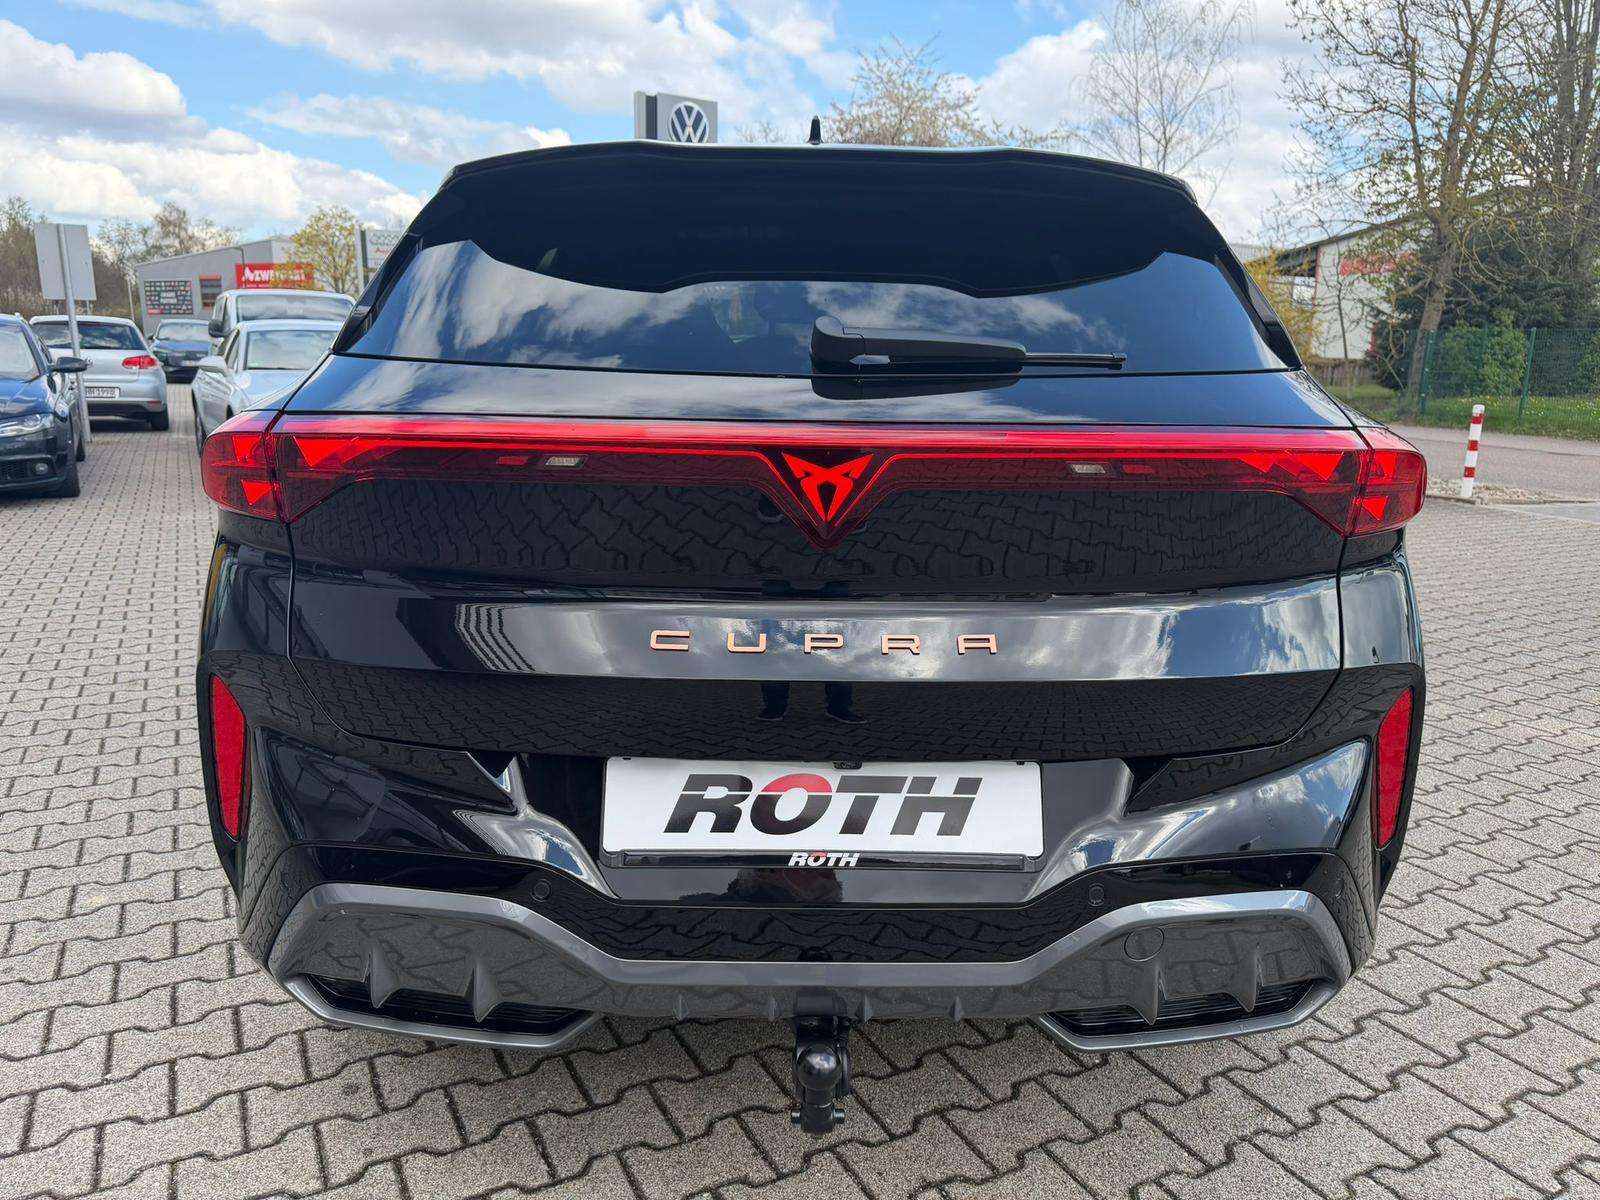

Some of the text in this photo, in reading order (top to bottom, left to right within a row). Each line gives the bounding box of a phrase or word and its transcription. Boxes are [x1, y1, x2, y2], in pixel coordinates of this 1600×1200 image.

[650, 629, 998, 655] CUPRA
[663, 773, 983, 836] ROTH
[787, 850, 861, 868] ROTH
